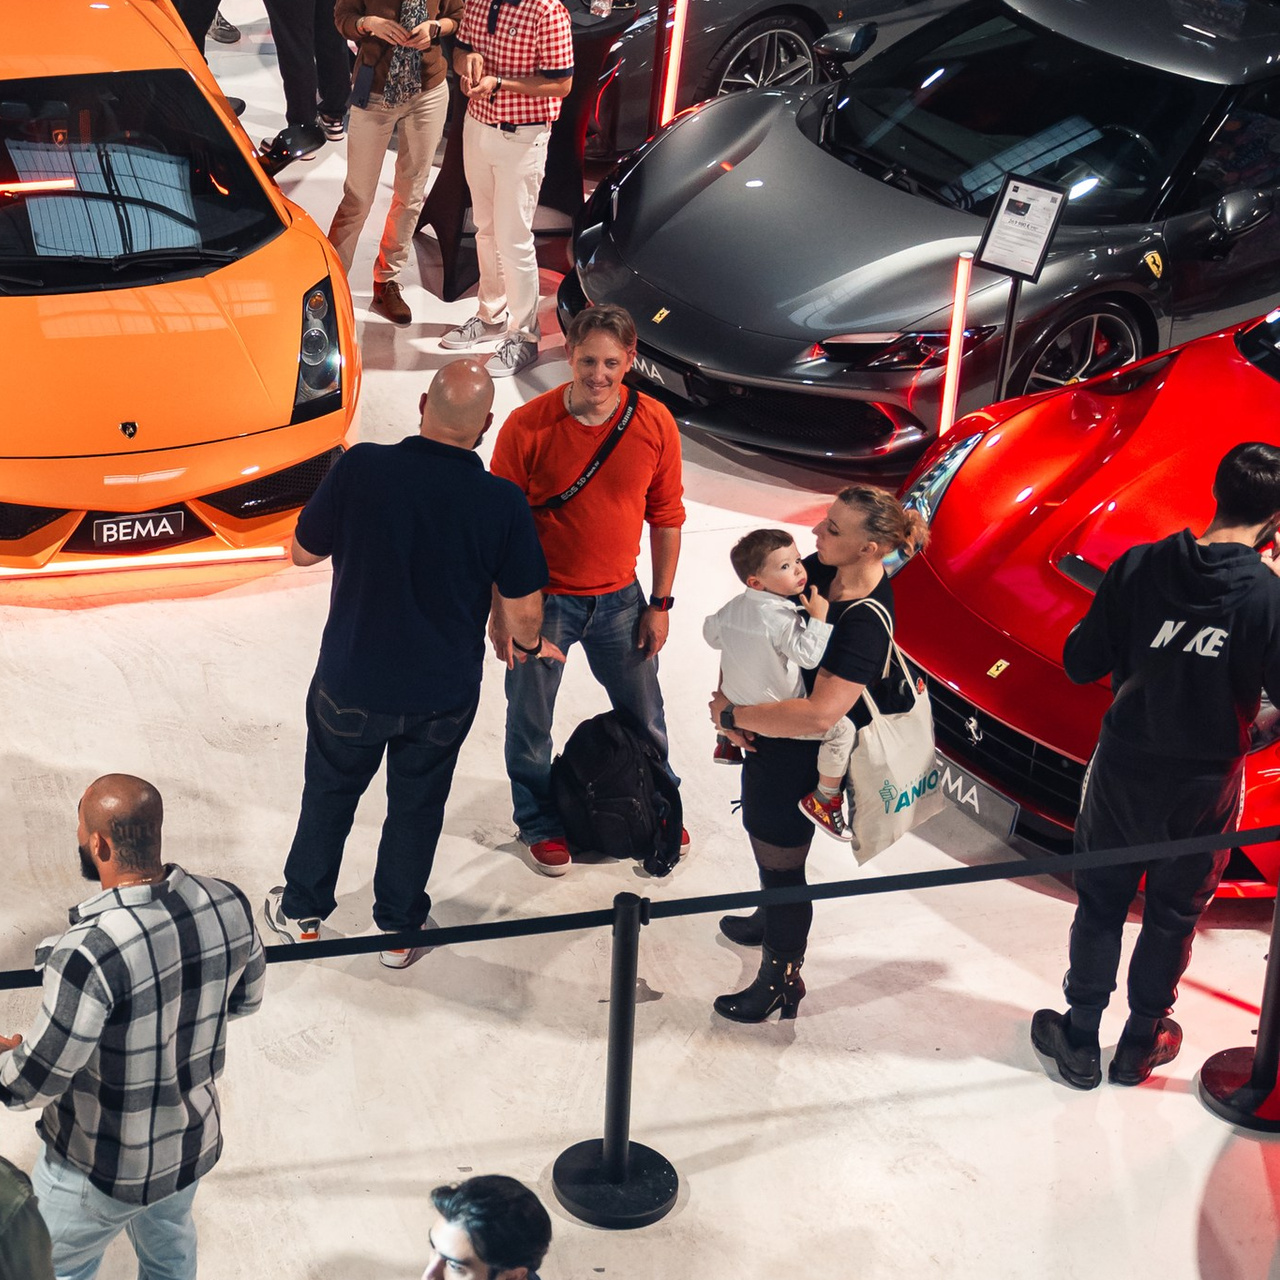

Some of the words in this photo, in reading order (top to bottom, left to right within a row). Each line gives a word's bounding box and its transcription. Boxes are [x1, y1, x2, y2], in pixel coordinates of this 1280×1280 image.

[631, 356, 666, 385] MA
[617, 406, 634, 431] Canon
[560, 486, 579, 501] EOS
[102, 517, 175, 543] BEMA
[1149, 620, 1229, 658] NKE
[936, 759, 980, 815] MA
